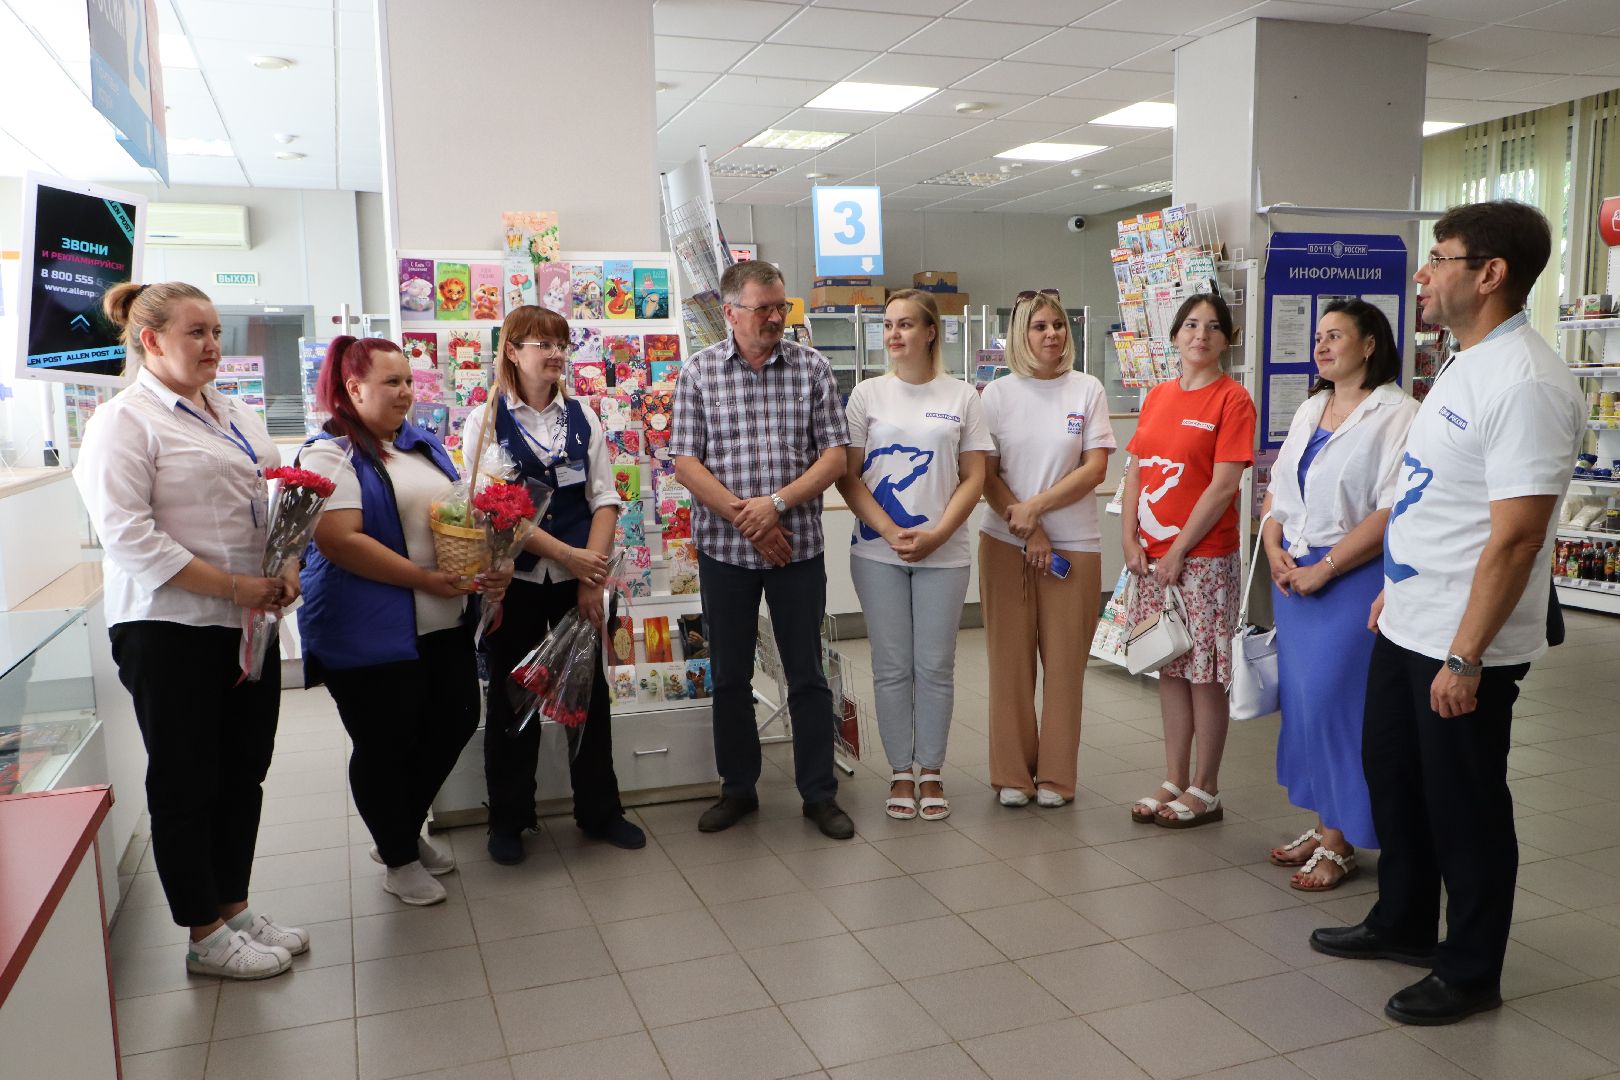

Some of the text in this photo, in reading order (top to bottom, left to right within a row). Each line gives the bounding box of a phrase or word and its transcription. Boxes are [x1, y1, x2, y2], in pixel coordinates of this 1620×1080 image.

[119, 215, 132, 232] POST
[833, 200, 866, 245] 3
[61, 237, 109, 256] ЗВОНИ
[1309, 245, 1367, 254] ПОЧТА РОССИИ
[42, 250, 125, 272] И РЕКЛАМИРУЙСЯ!
[41, 268, 49, 278] 8
[51, 270, 73, 282] 800
[74, 273, 94, 285] 555
[218, 274, 256, 284] ВЫХОД
[1289, 266, 1382, 280] ИНФОРМАЦИЯ
[43, 355, 62, 364] POST
[66, 350, 90, 361] ALLEN
[91, 349, 110, 358] POST
